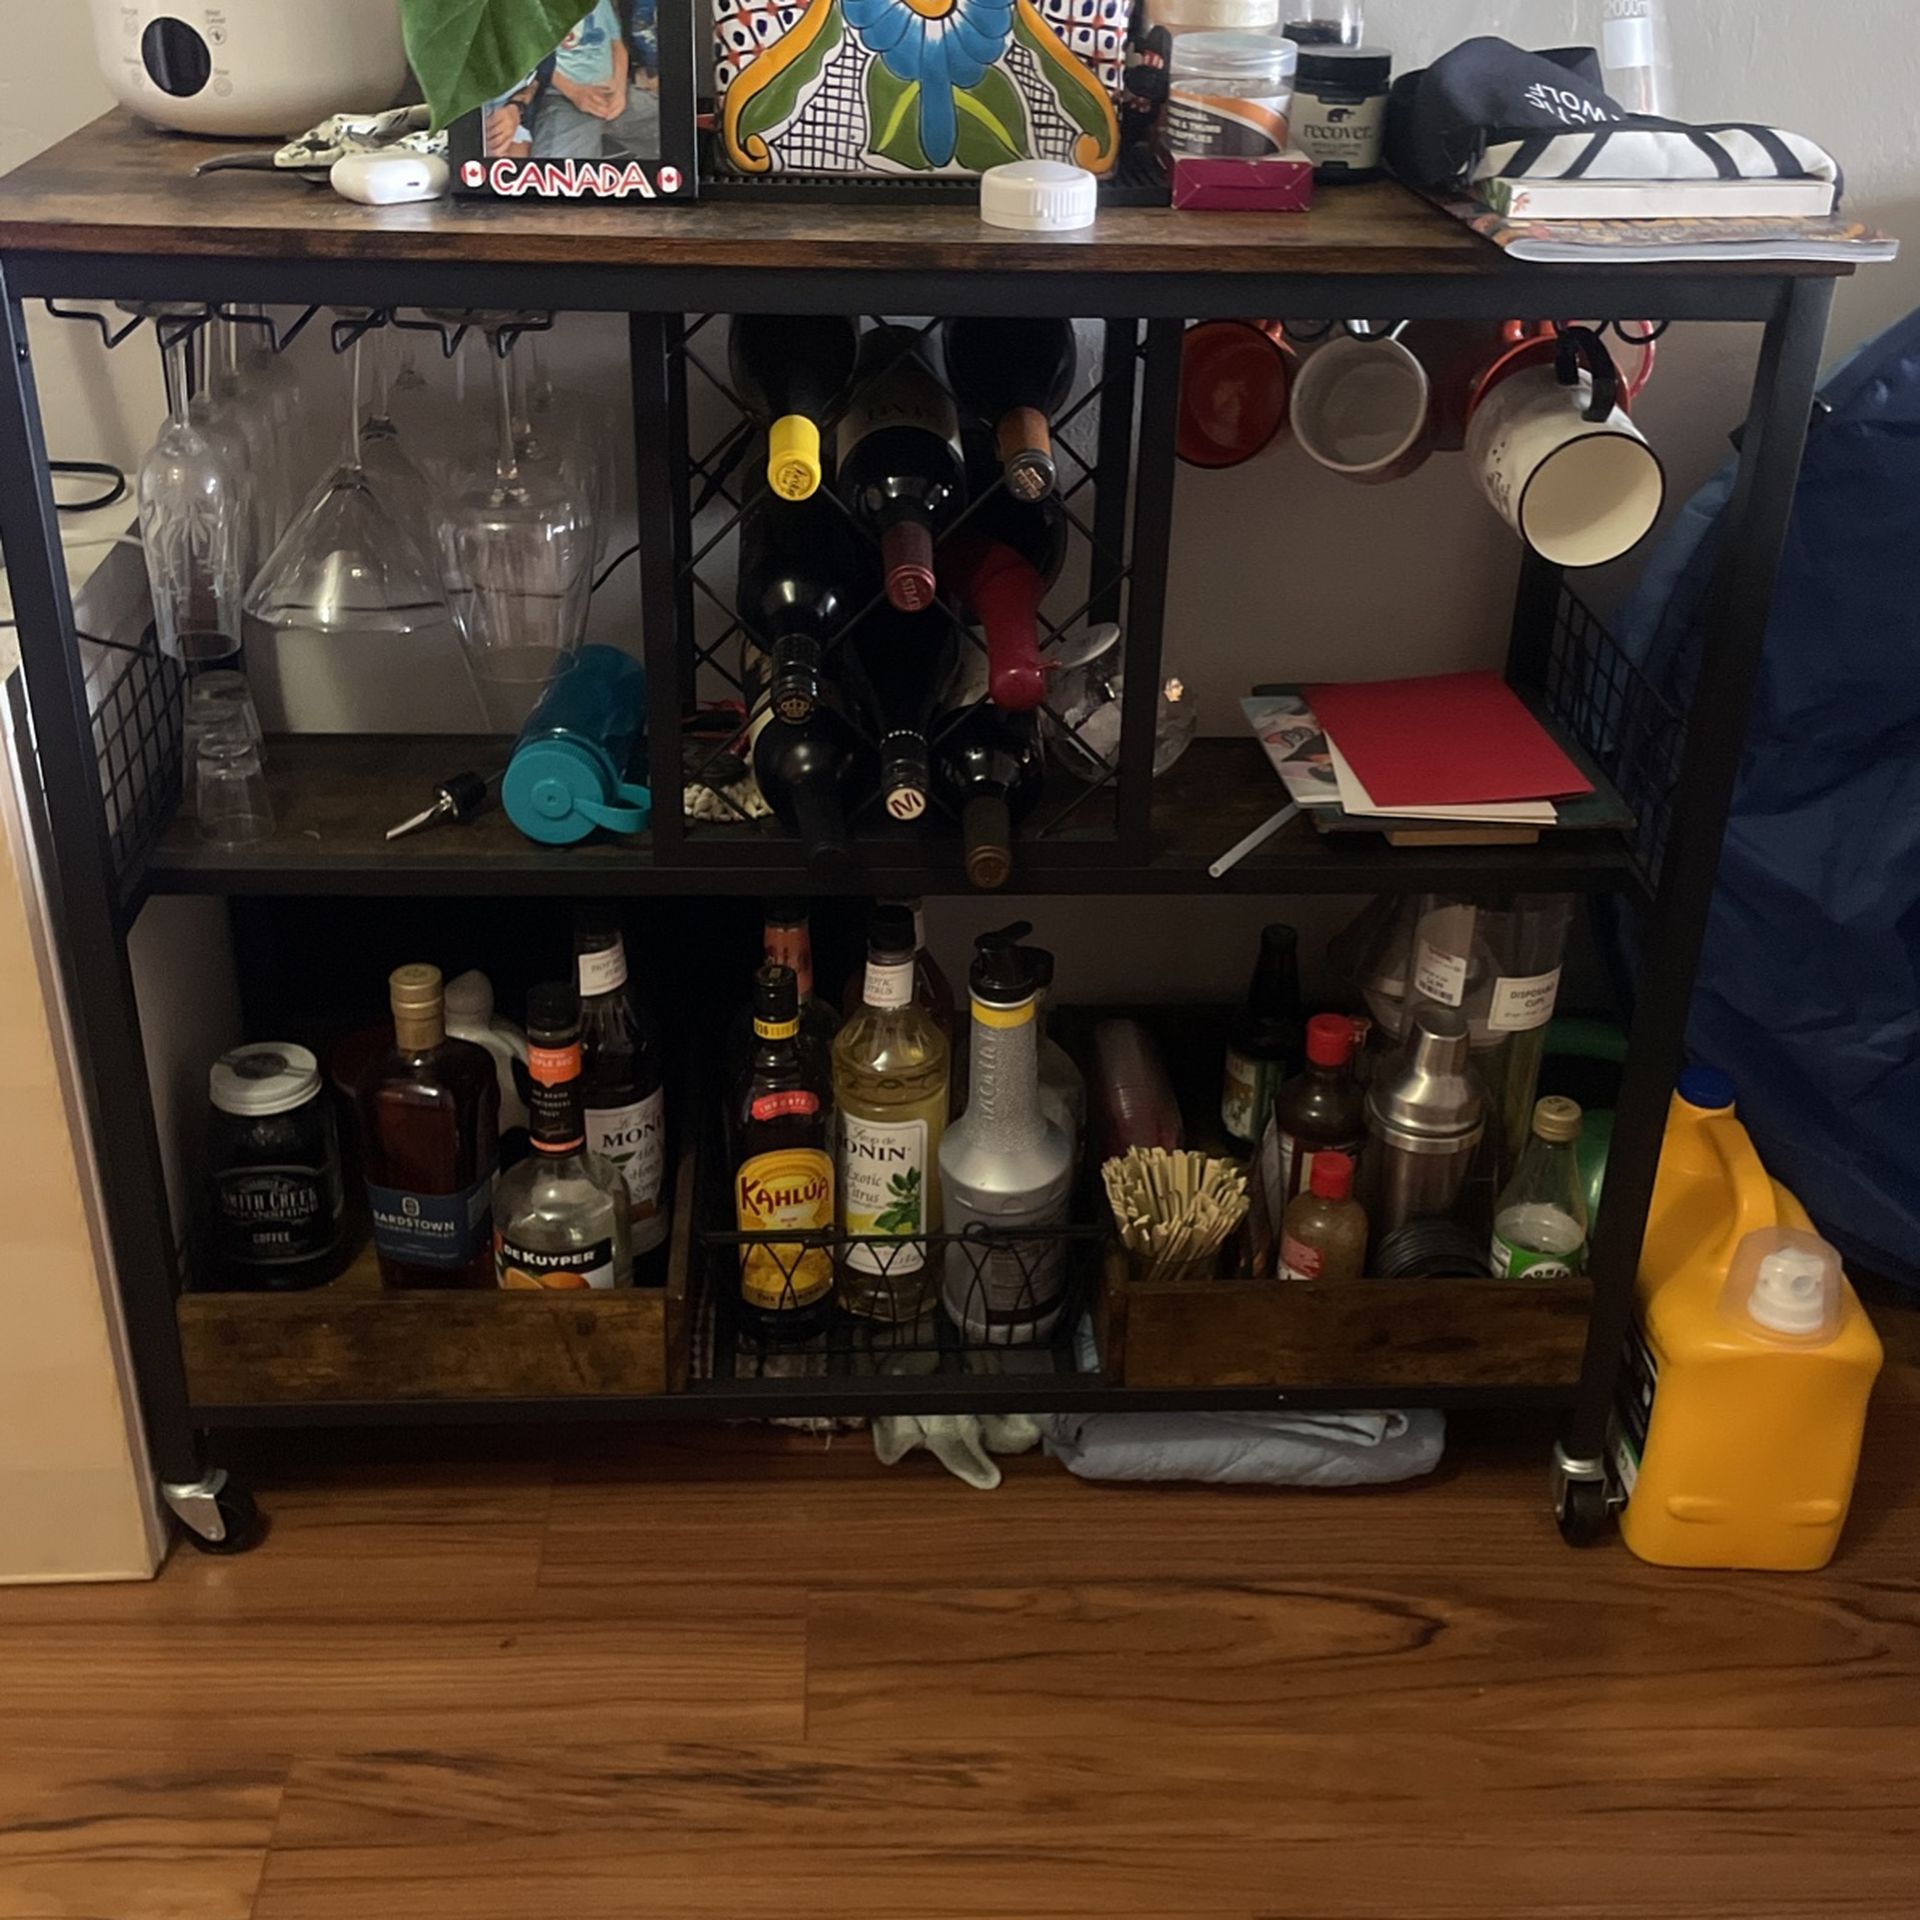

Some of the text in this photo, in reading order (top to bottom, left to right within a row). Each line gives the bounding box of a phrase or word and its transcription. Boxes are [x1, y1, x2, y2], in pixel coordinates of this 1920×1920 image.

[490, 157, 657, 198] CANADA
[602, 1114, 662, 1149] MONI
[843, 1139, 907, 1161] ONIN
[741, 1176, 829, 1215] KAHLÚA
[252, 1231, 290, 1244] COFFEE
[522, 1250, 595, 1267] KUYPER
